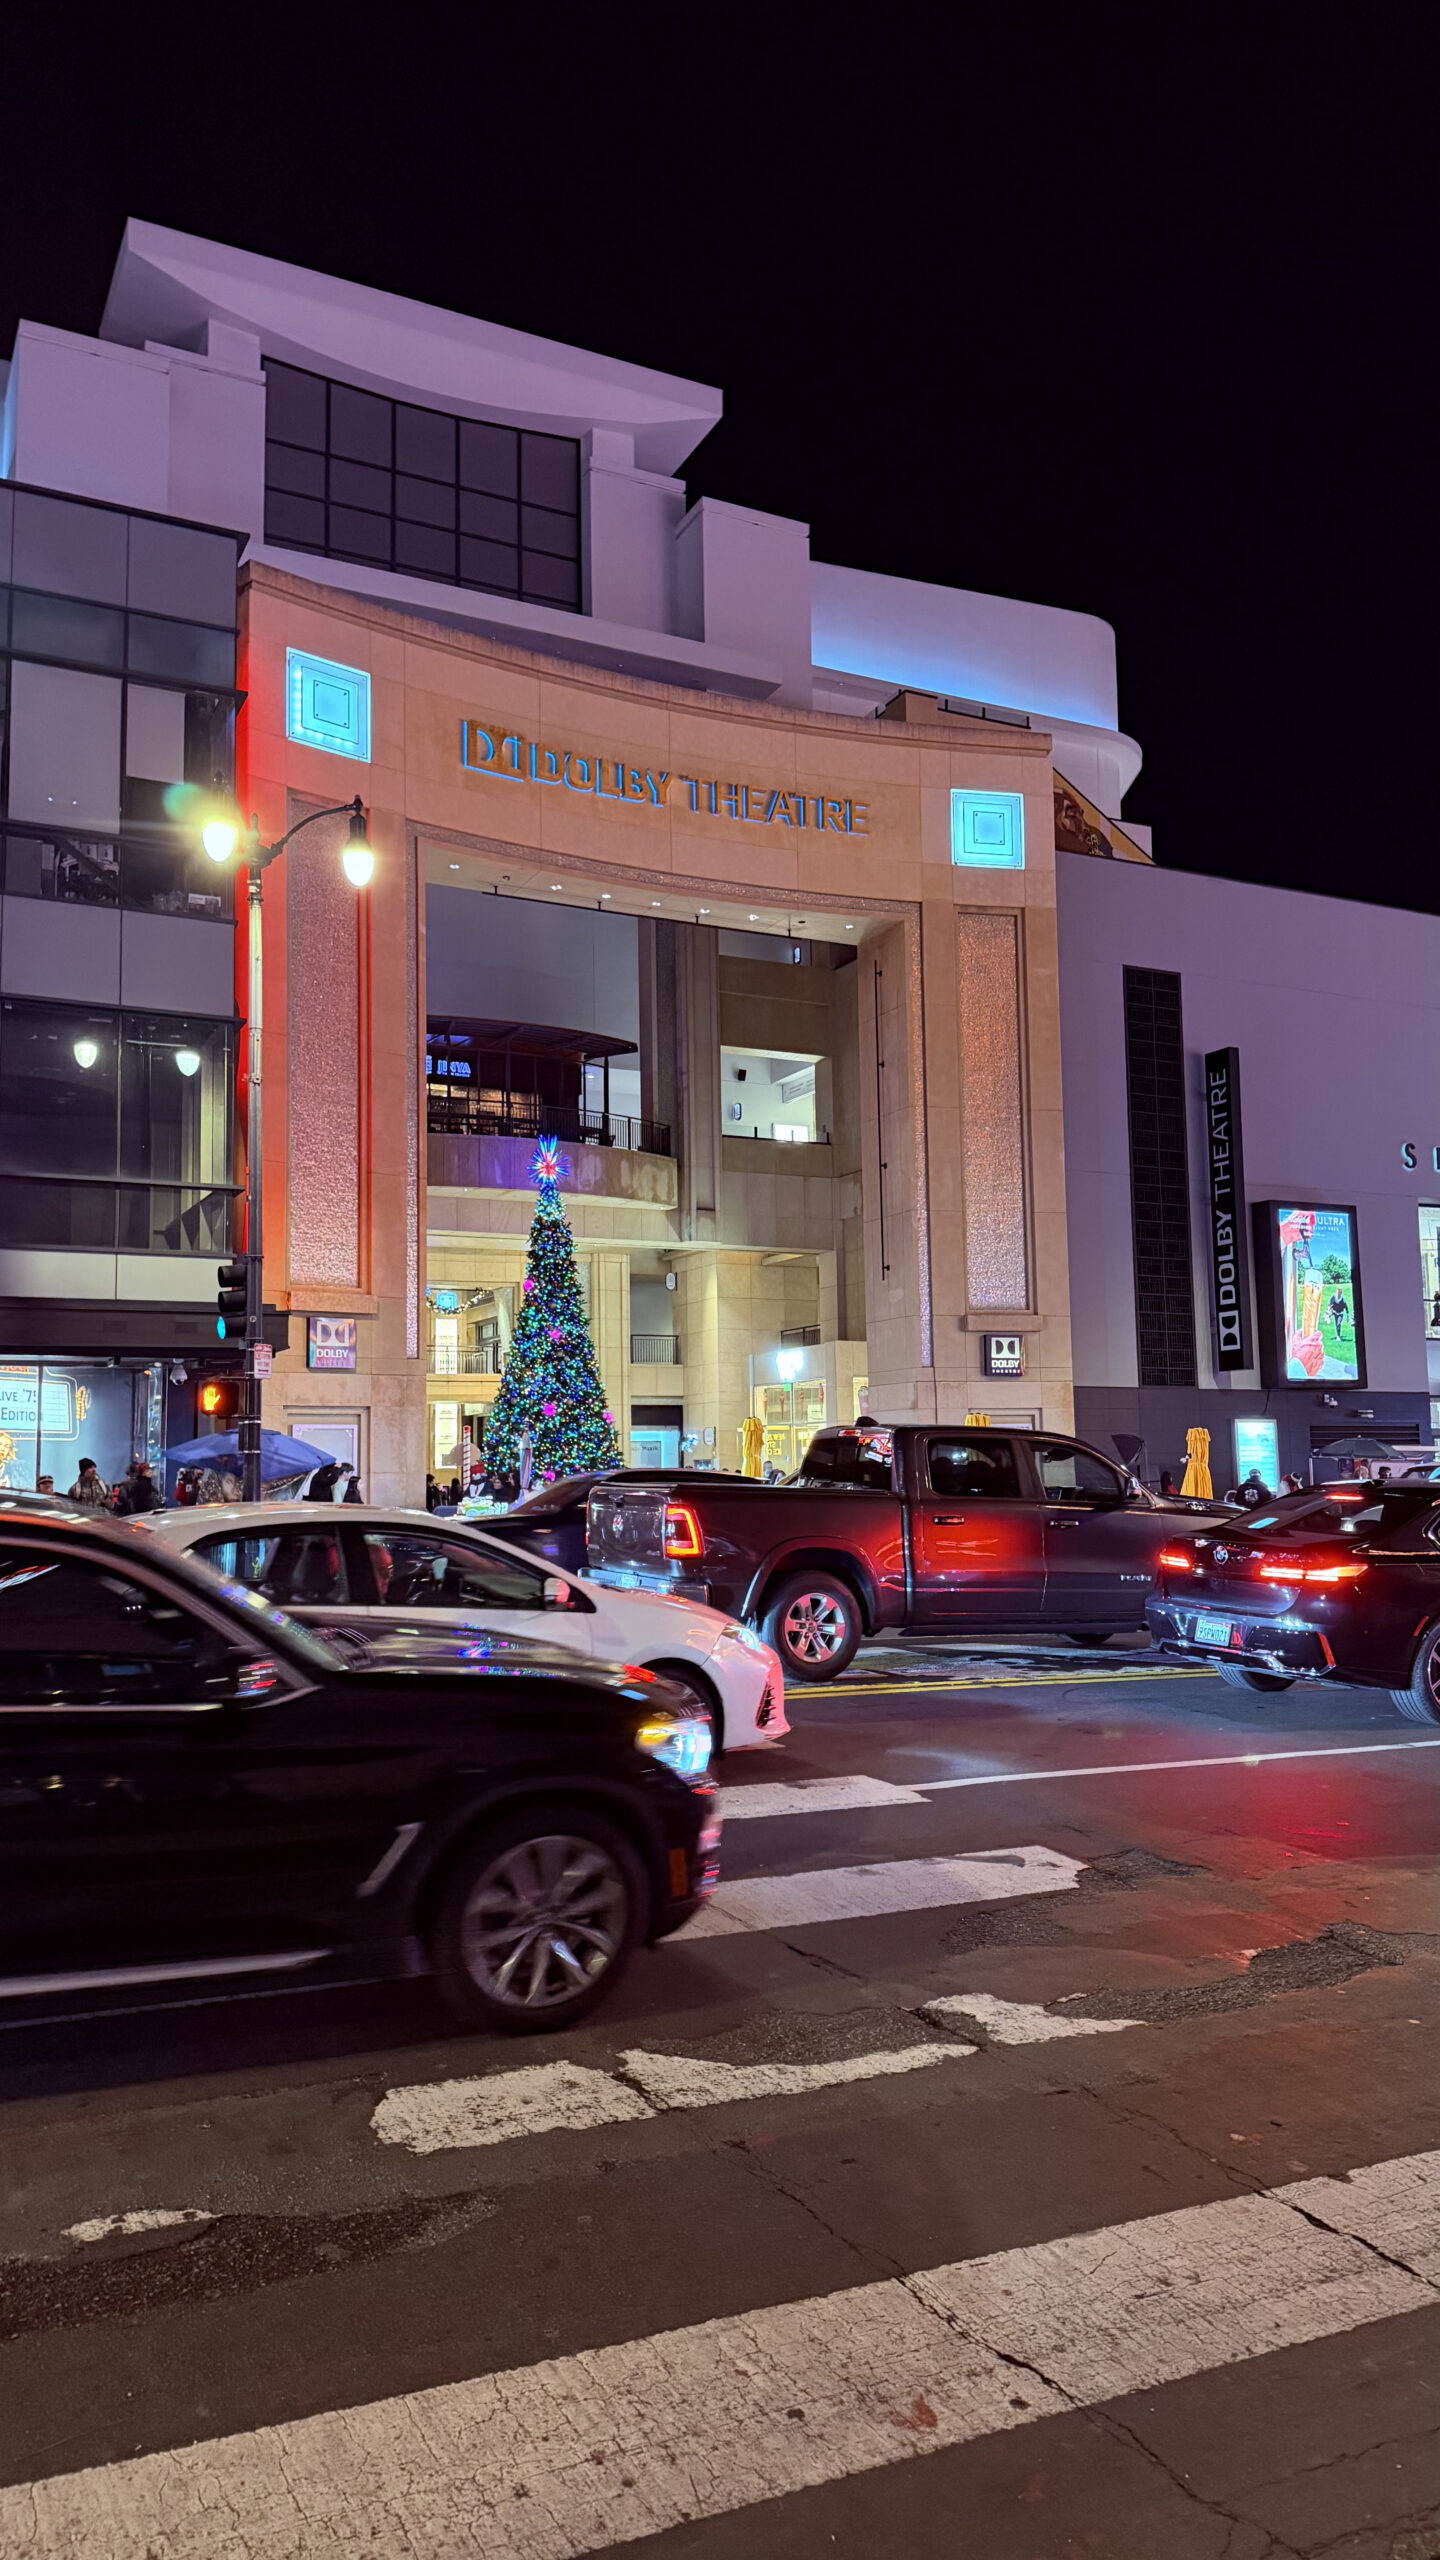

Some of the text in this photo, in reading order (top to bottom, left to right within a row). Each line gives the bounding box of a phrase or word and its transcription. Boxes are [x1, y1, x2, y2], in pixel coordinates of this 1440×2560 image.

[530, 743, 871, 837] DOLBY THEATRE
[1210, 1068, 1236, 1305] DOLBY THEATRE
[1317, 1216, 1345, 1226] ULTRA
[316, 1348, 348, 1358] DOLBY
[991, 1359, 1020, 1368] DOLBY
[0, 1391, 18, 1402] IVE
[1, 1407, 37, 1422] EDITIO
